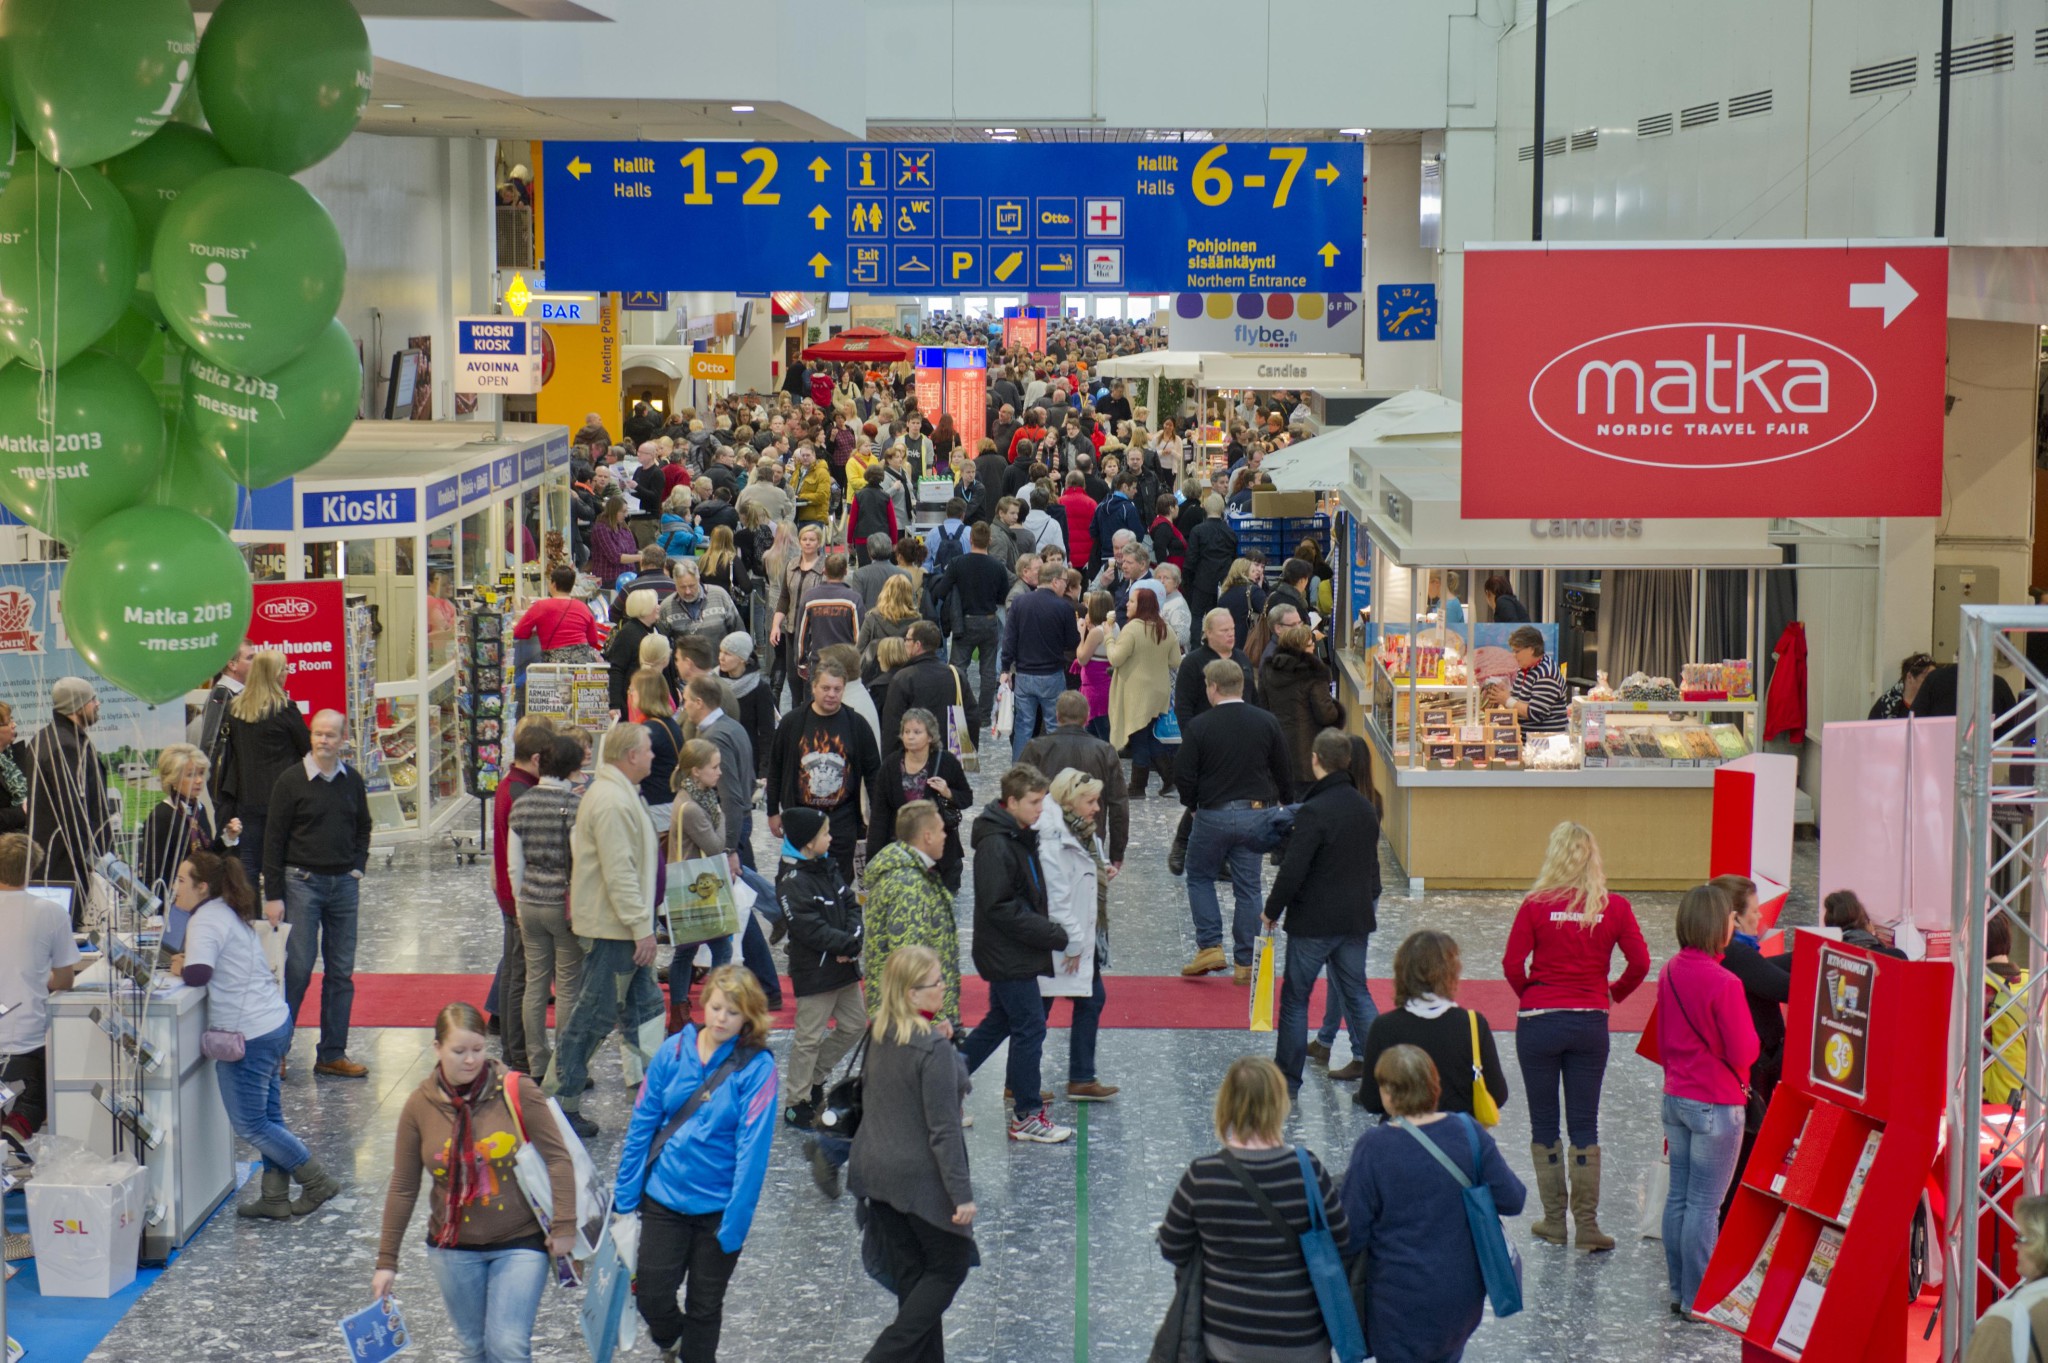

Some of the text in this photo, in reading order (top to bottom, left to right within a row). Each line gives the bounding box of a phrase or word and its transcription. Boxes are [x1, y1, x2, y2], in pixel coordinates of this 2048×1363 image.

[613, 146, 781, 205] Hallit 1-2
[1137, 143, 1308, 209] Hallit 6-7
[614, 182, 652, 198] Halls
[1137, 179, 1175, 196] Halls
[911, 201, 931, 213] WC
[1000, 213, 1017, 223] LIFT
[189, 243, 249, 260] TOURIST
[857, 248, 879, 261] Exit
[1187, 238, 1258, 255] Pohjoinen
[952, 252, 974, 279] P
[1188, 254, 1276, 272] sisäänkäynti
[1187, 273, 1307, 288] Northern Entrance
[1402, 288, 1411, 297] 12
[542, 304, 581, 319] BAR
[1425, 307, 1431, 316] 3
[471, 325, 514, 337] KIOSKI
[1404, 328, 1410, 337] 6
[474, 339, 511, 352] KIOSK
[601, 306, 614, 384] Meeting Poin
[467, 362, 519, 373] AVOINNA
[1577, 334, 1829, 414] matka
[190, 358, 279, 401] Matka 2013
[478, 376, 509, 387] OPEN
[193, 393, 258, 423] -messut
[1597, 422, 1809, 436] NORDIC TRAVEL FAIR
[55, 432, 102, 452] 2013
[10, 462, 89, 480] -messut
[322, 493, 398, 523] Kioski
[123, 602, 232, 625] Matka 2013
[264, 598, 310, 614] matka
[139, 632, 219, 651] -messut
[299, 659, 332, 671] Room
